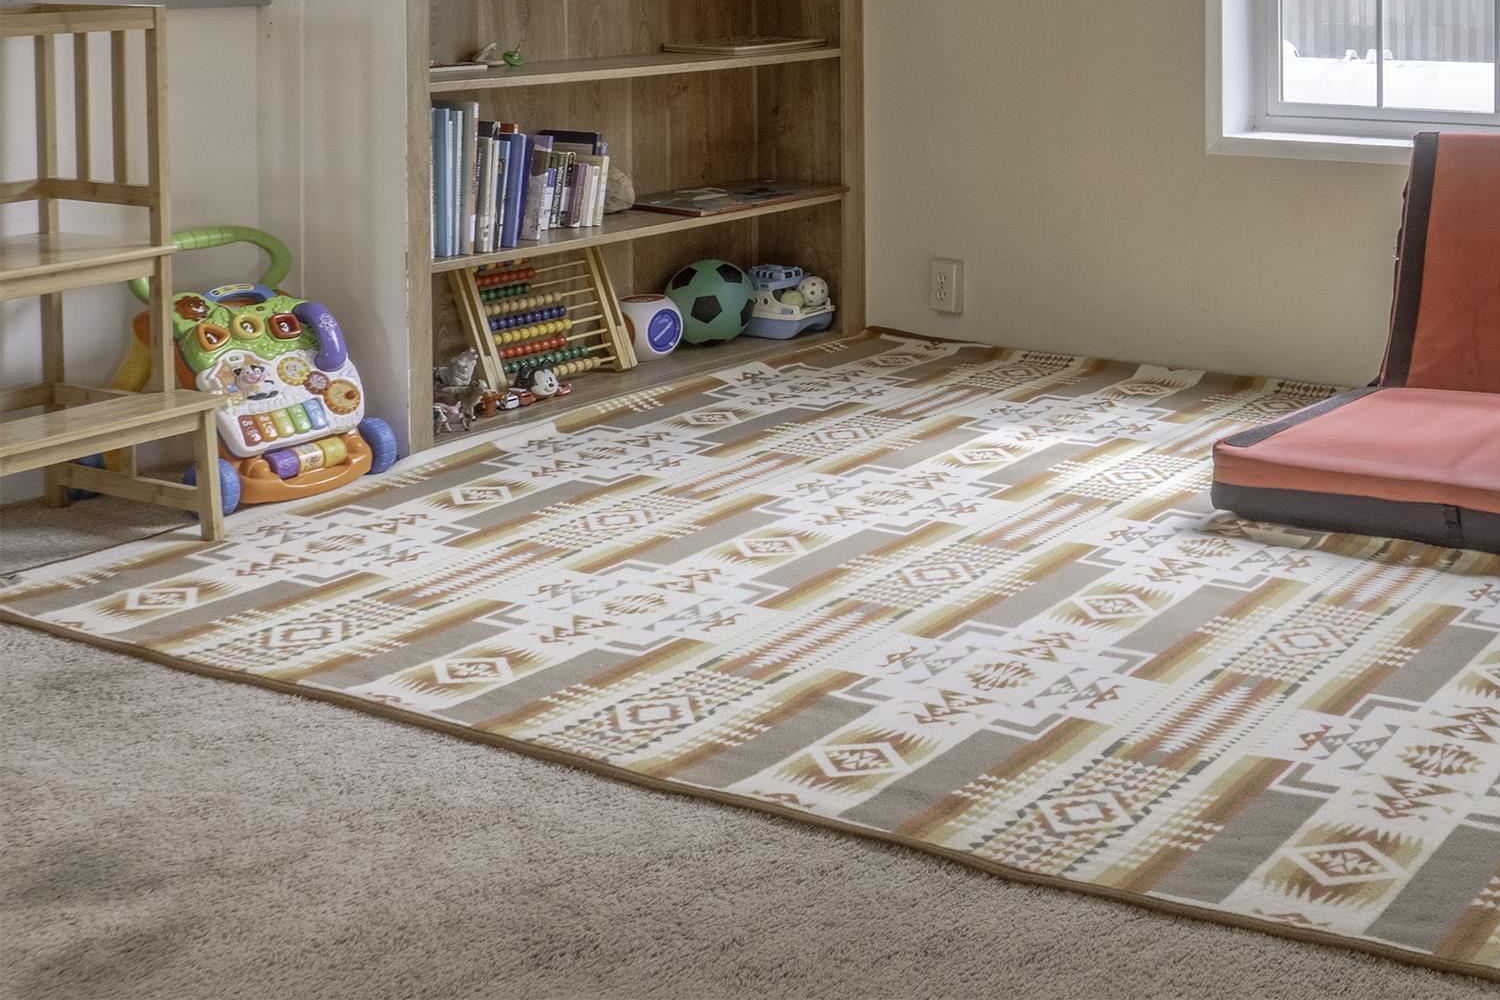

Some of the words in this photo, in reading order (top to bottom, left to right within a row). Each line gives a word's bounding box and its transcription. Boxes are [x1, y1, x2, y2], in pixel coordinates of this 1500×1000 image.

[242, 322, 254, 334] 2
[279, 322, 290, 333] 3
[206, 333, 218, 344] 1
